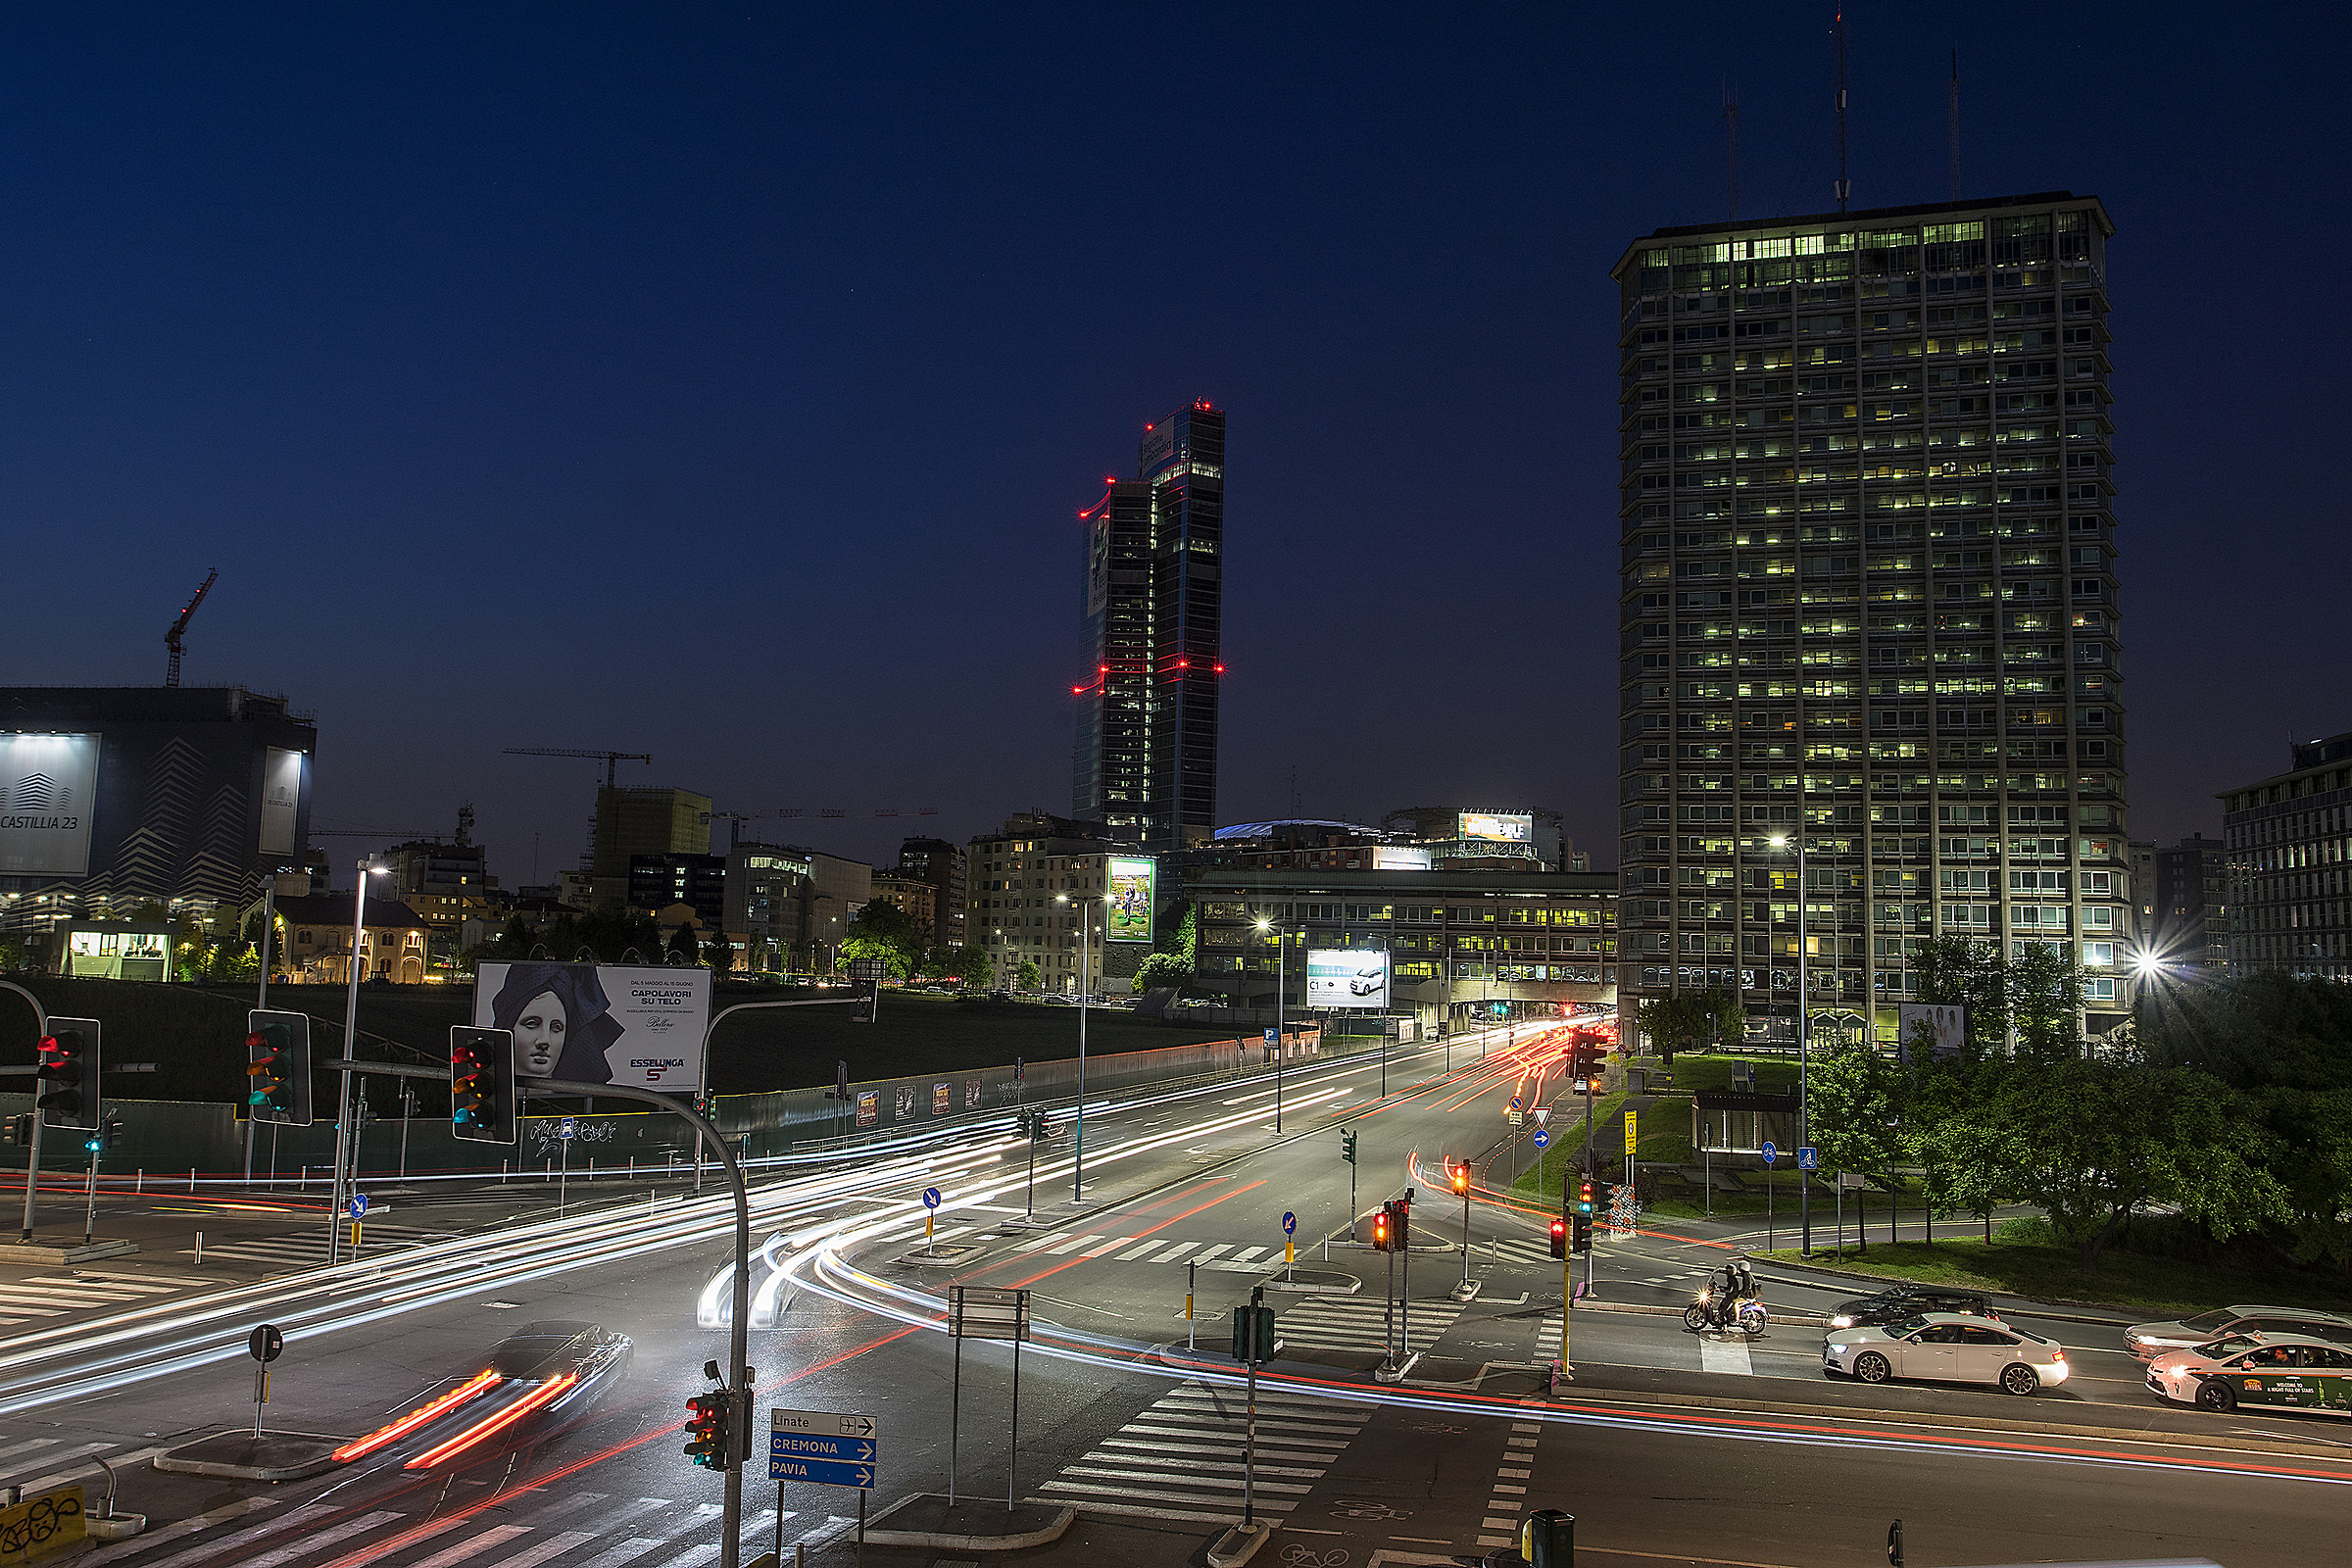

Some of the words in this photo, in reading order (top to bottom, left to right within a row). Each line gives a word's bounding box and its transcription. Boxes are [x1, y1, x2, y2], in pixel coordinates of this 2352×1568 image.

[0, 815, 59, 829] CASTILLIA
[61, 816, 78, 830] 23
[1309, 981, 1319, 990] C1
[1265, 1029, 1274, 1040] P
[630, 1058, 684, 1068] ESSELUNGA
[773, 1414, 809, 1428] Linate
[773, 1438, 839, 1454] CREMONA
[771, 1461, 808, 1476] PAVIA
